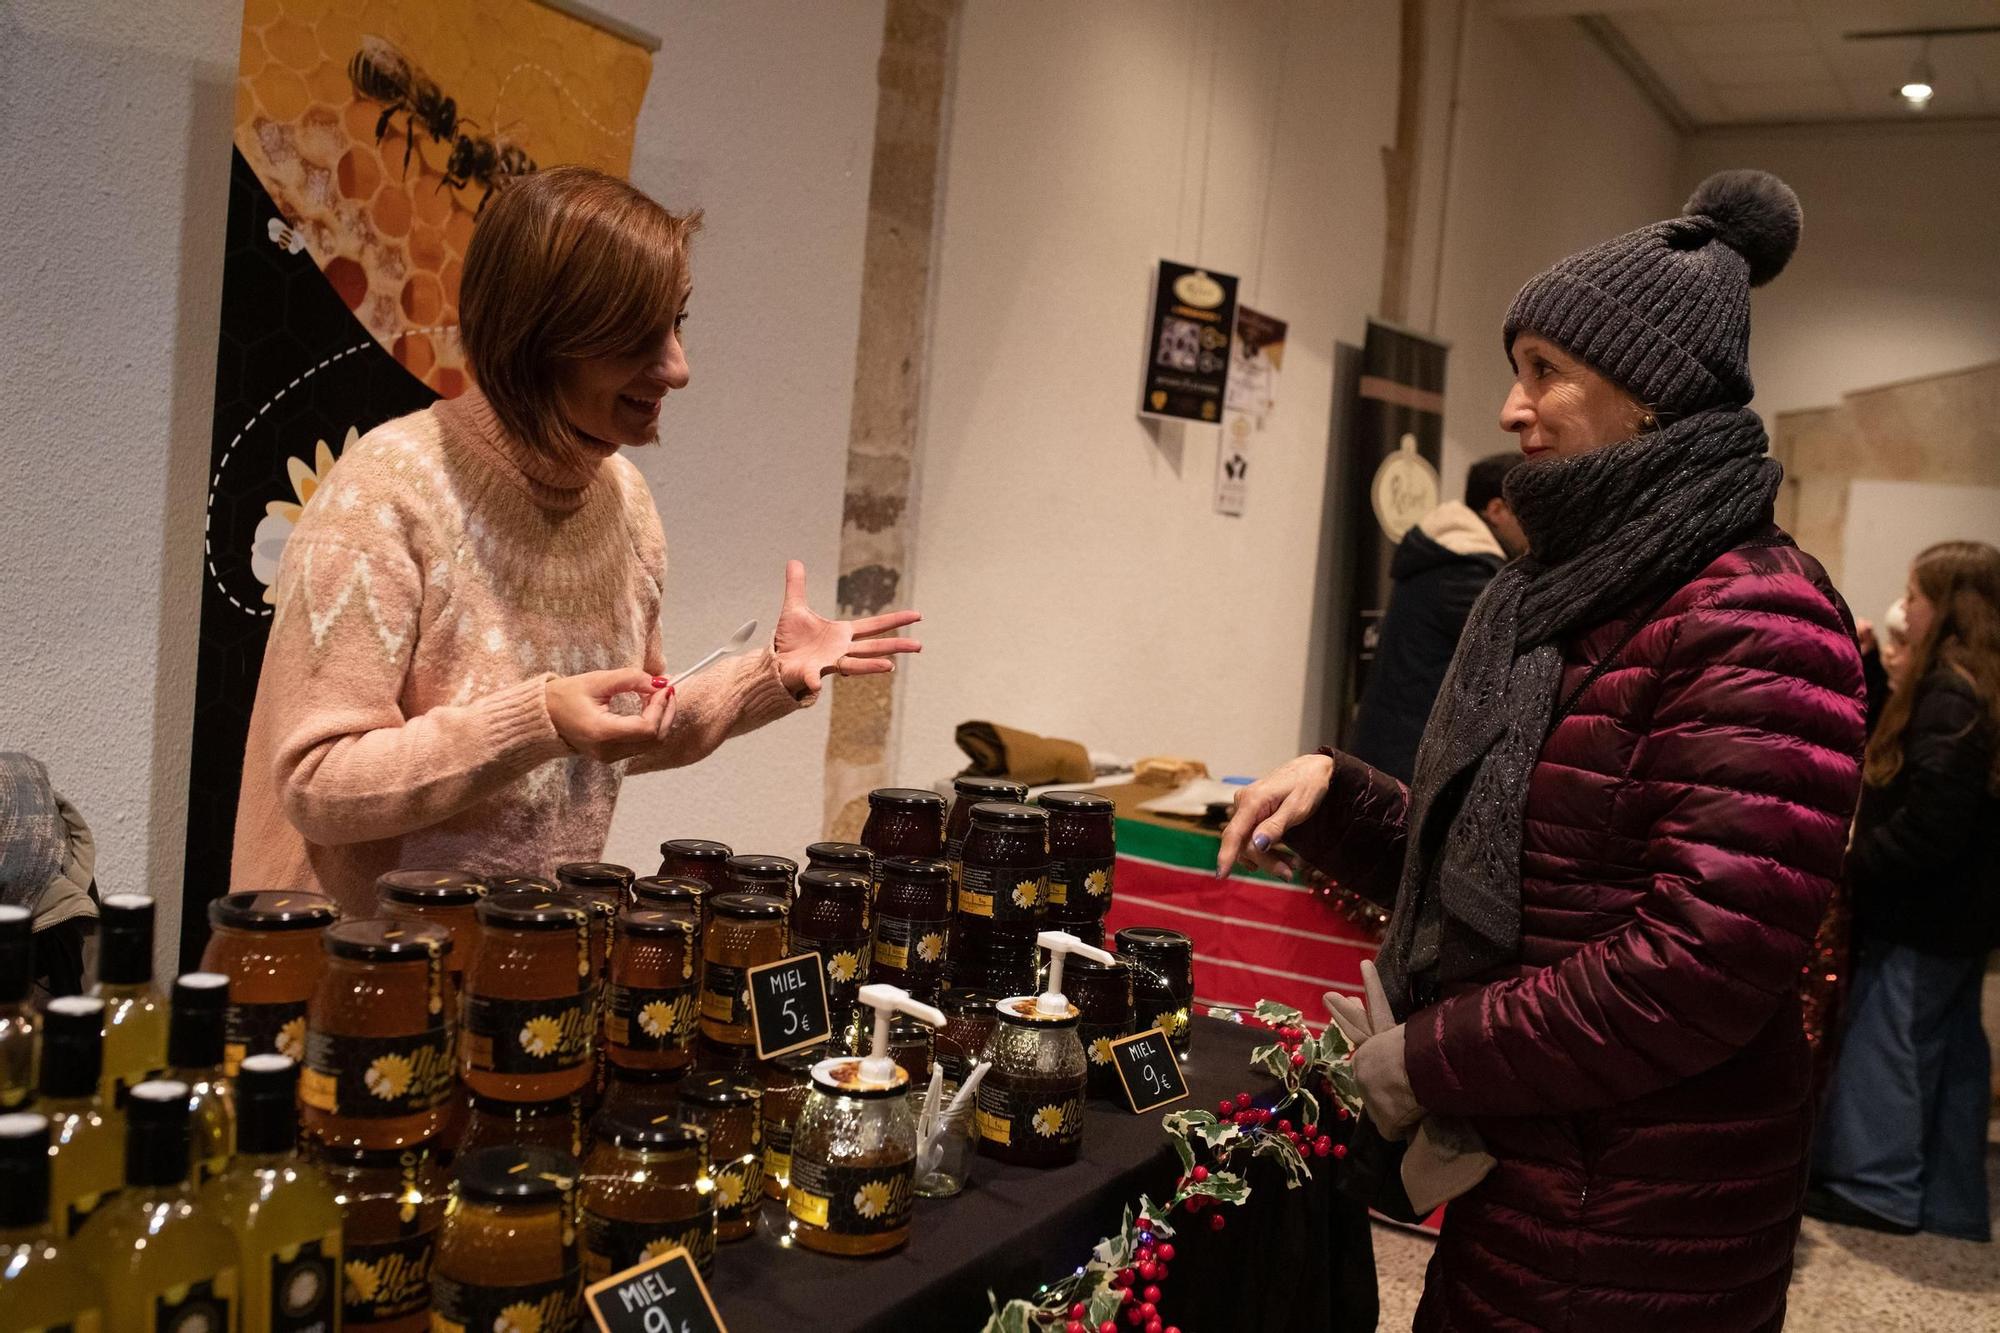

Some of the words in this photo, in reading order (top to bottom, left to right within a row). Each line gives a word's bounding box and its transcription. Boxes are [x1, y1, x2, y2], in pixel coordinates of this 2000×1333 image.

[770, 969, 806, 995] MIEL
[1128, 1041, 1157, 1062] MIEL
[618, 1271, 676, 1313] MIEL
